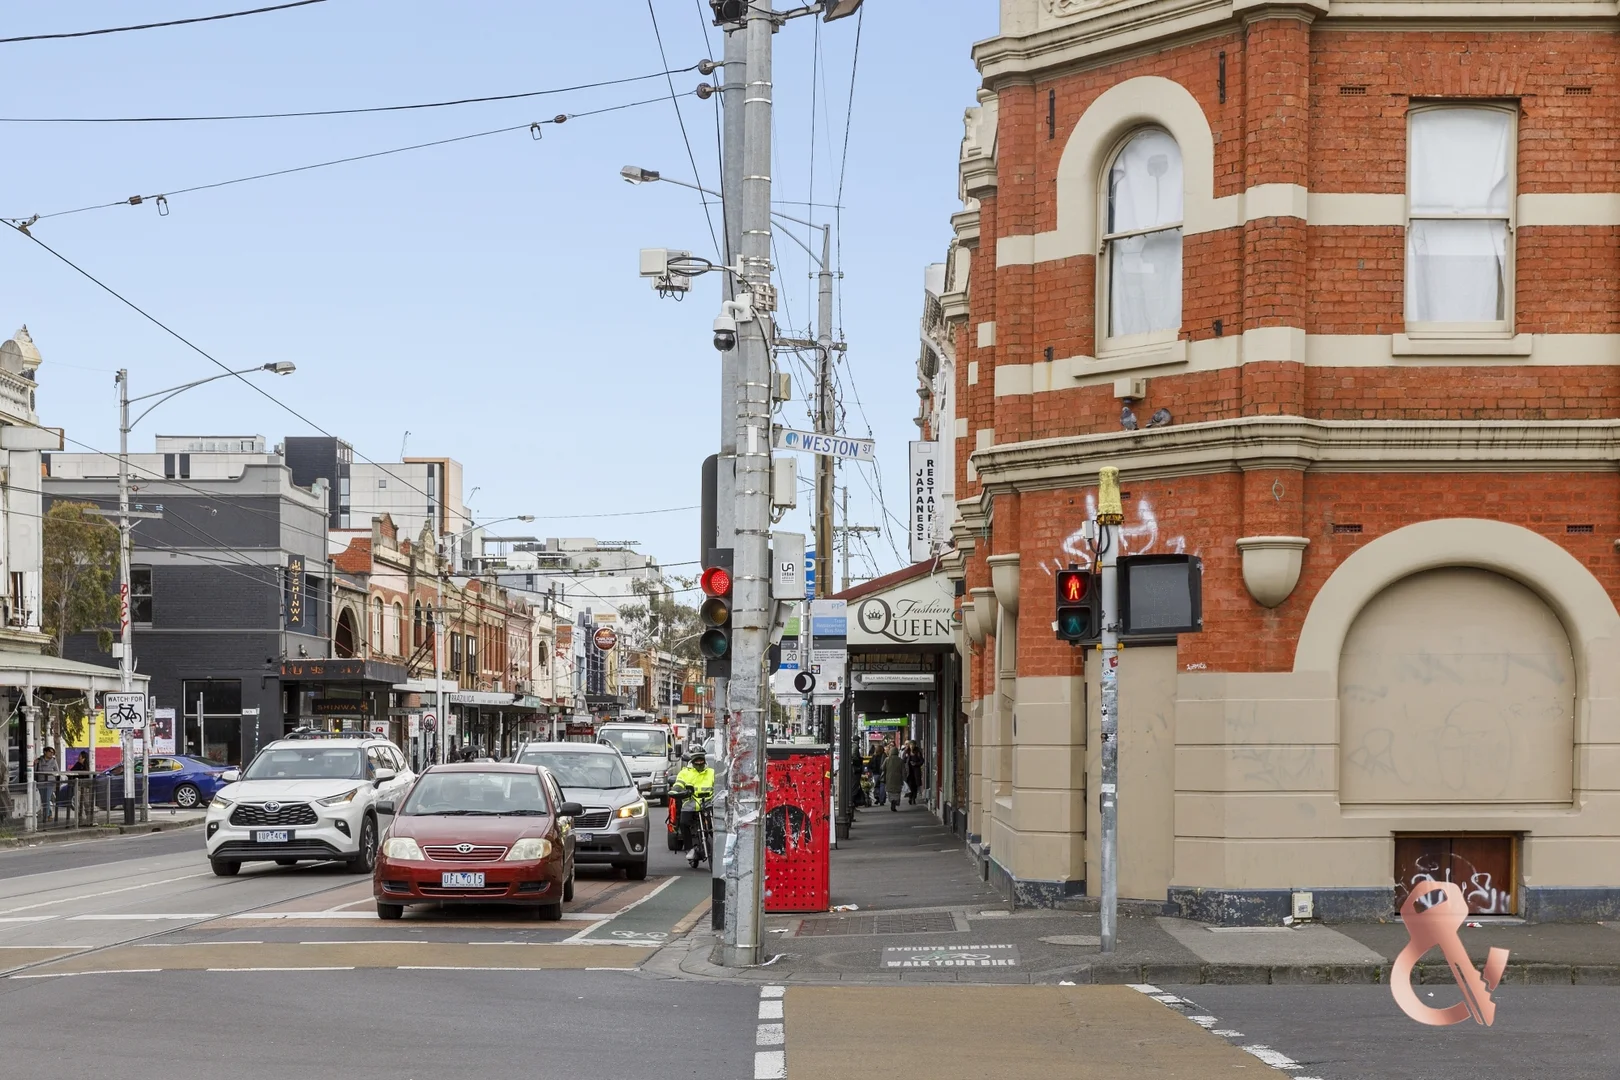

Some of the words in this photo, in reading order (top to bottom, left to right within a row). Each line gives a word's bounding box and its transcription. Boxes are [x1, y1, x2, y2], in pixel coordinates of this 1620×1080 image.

[802, 434, 859, 457] WESTON
[862, 444, 872, 453] ST
[916, 468, 924, 541] JAPANESE
[926, 459, 935, 544] RESTAUR
[892, 598, 951, 619] Fashion
[857, 597, 951, 643] QUEEN
[786, 653, 797, 661] 20
[443, 874, 460, 884] UFL
[466, 874, 483, 884] 015
[935, 959, 976, 967] YOUR
[980, 959, 1016, 967] BIKE
